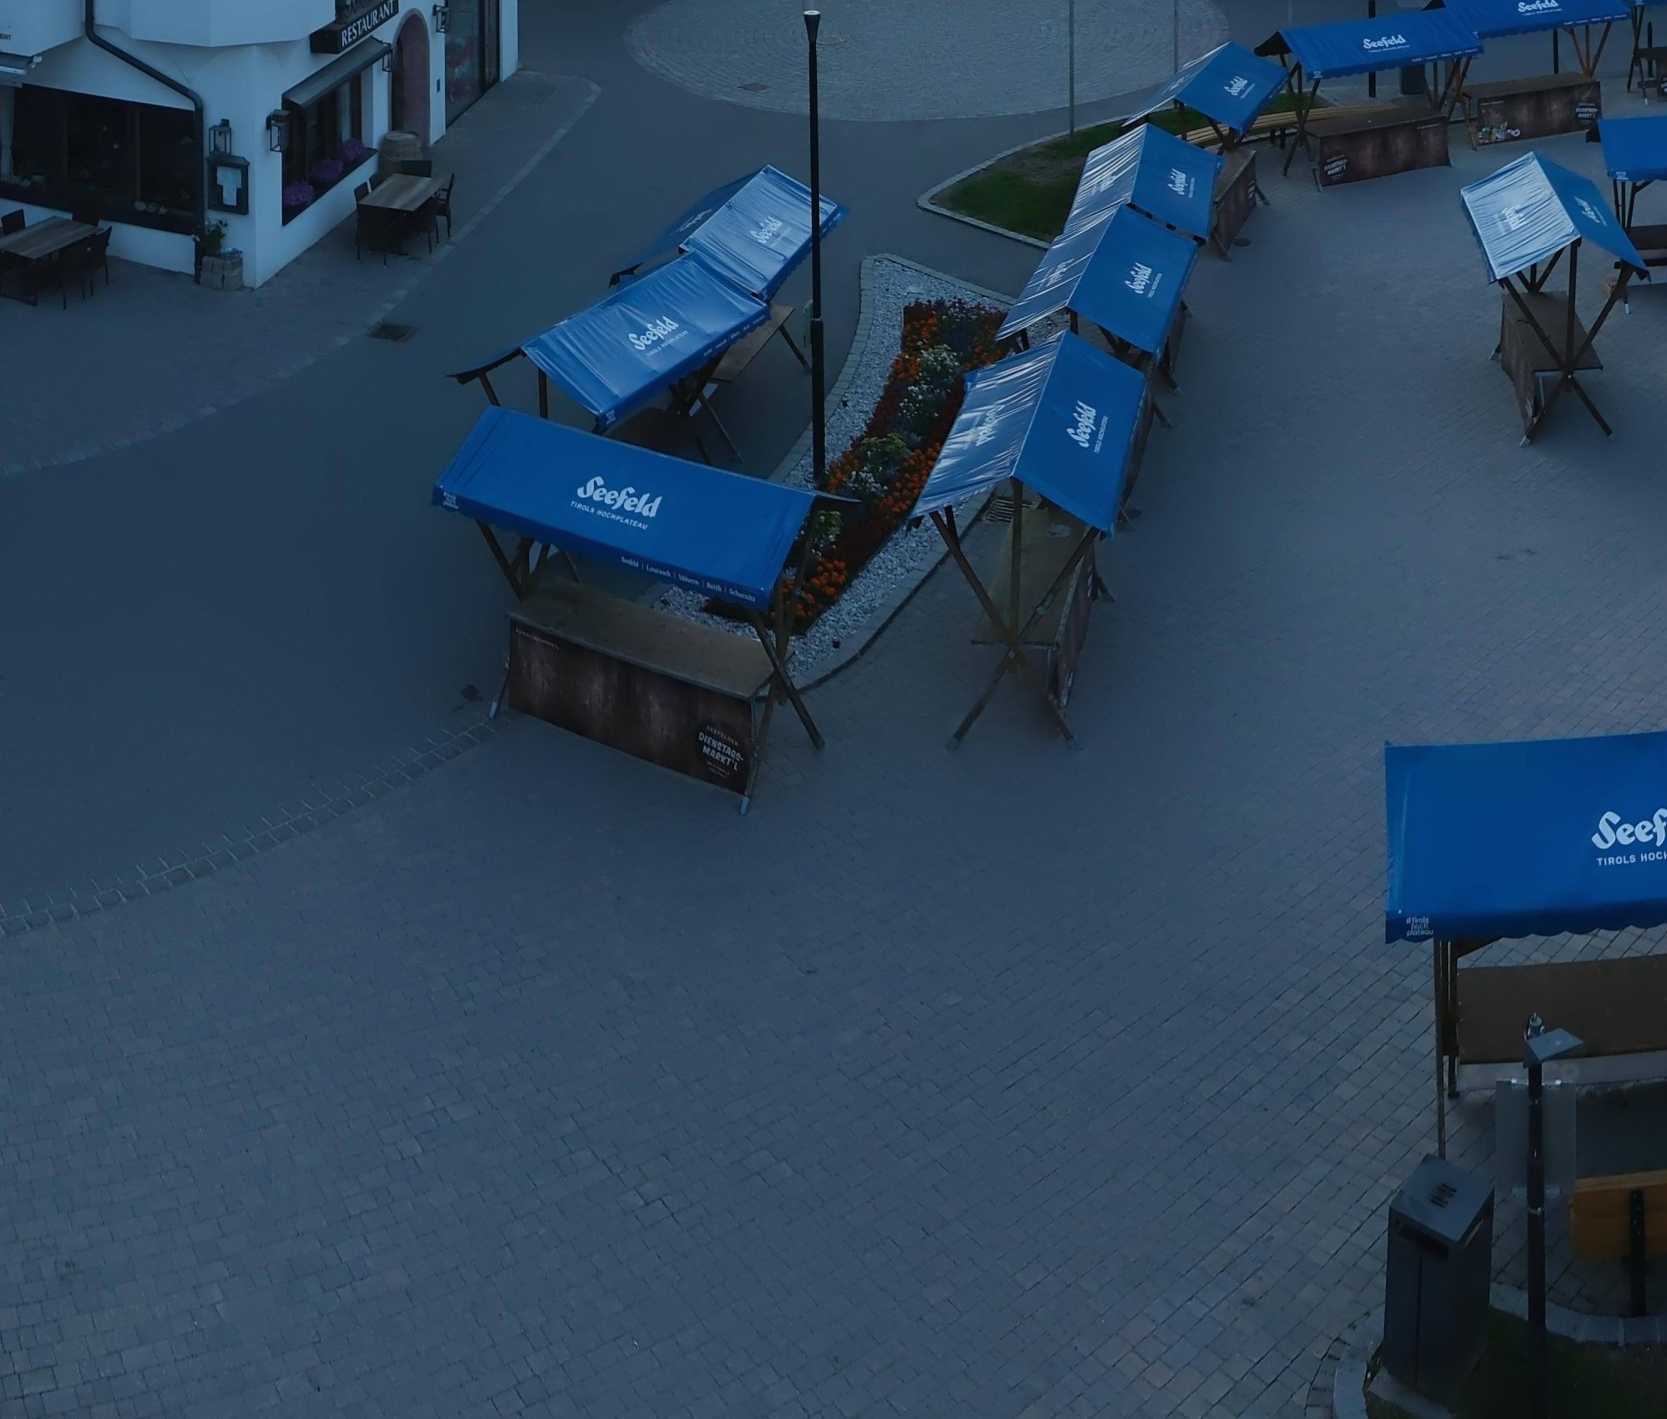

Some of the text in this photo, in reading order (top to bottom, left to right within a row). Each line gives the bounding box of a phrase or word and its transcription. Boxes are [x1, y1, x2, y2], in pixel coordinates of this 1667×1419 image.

[1362, 33, 1408, 51] Seefeld
[629, 314, 681, 351] Seefeld
[1066, 400, 1098, 449] Seefeld
[577, 475, 663, 519] Seefeld
[570, 499, 649, 531] TIROLS HOCHPLATEAU
[1596, 853, 1638, 867] TIROLS
